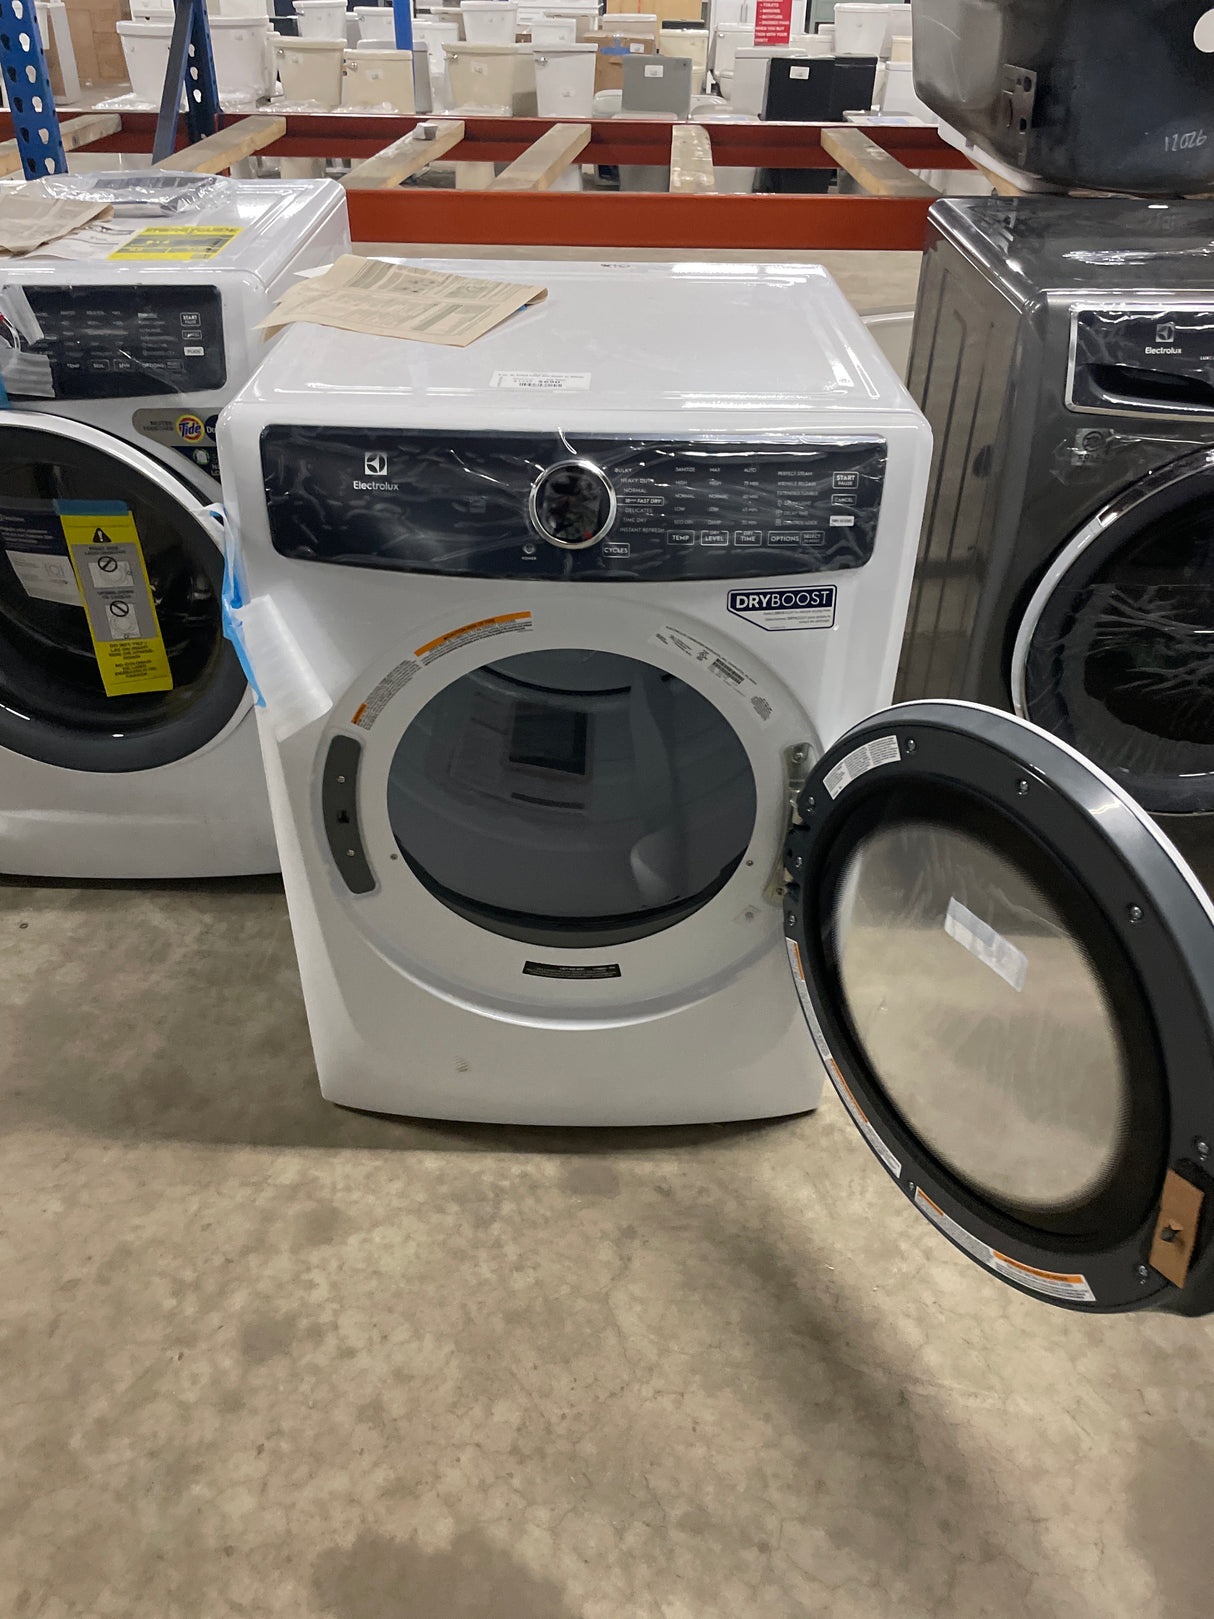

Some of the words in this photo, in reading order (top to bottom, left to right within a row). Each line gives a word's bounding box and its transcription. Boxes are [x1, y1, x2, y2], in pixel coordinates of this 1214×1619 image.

[179, 422, 201, 437] Tide
[353, 480, 399, 490] Electrolux
[736, 591, 830, 608] DRYBOOST
